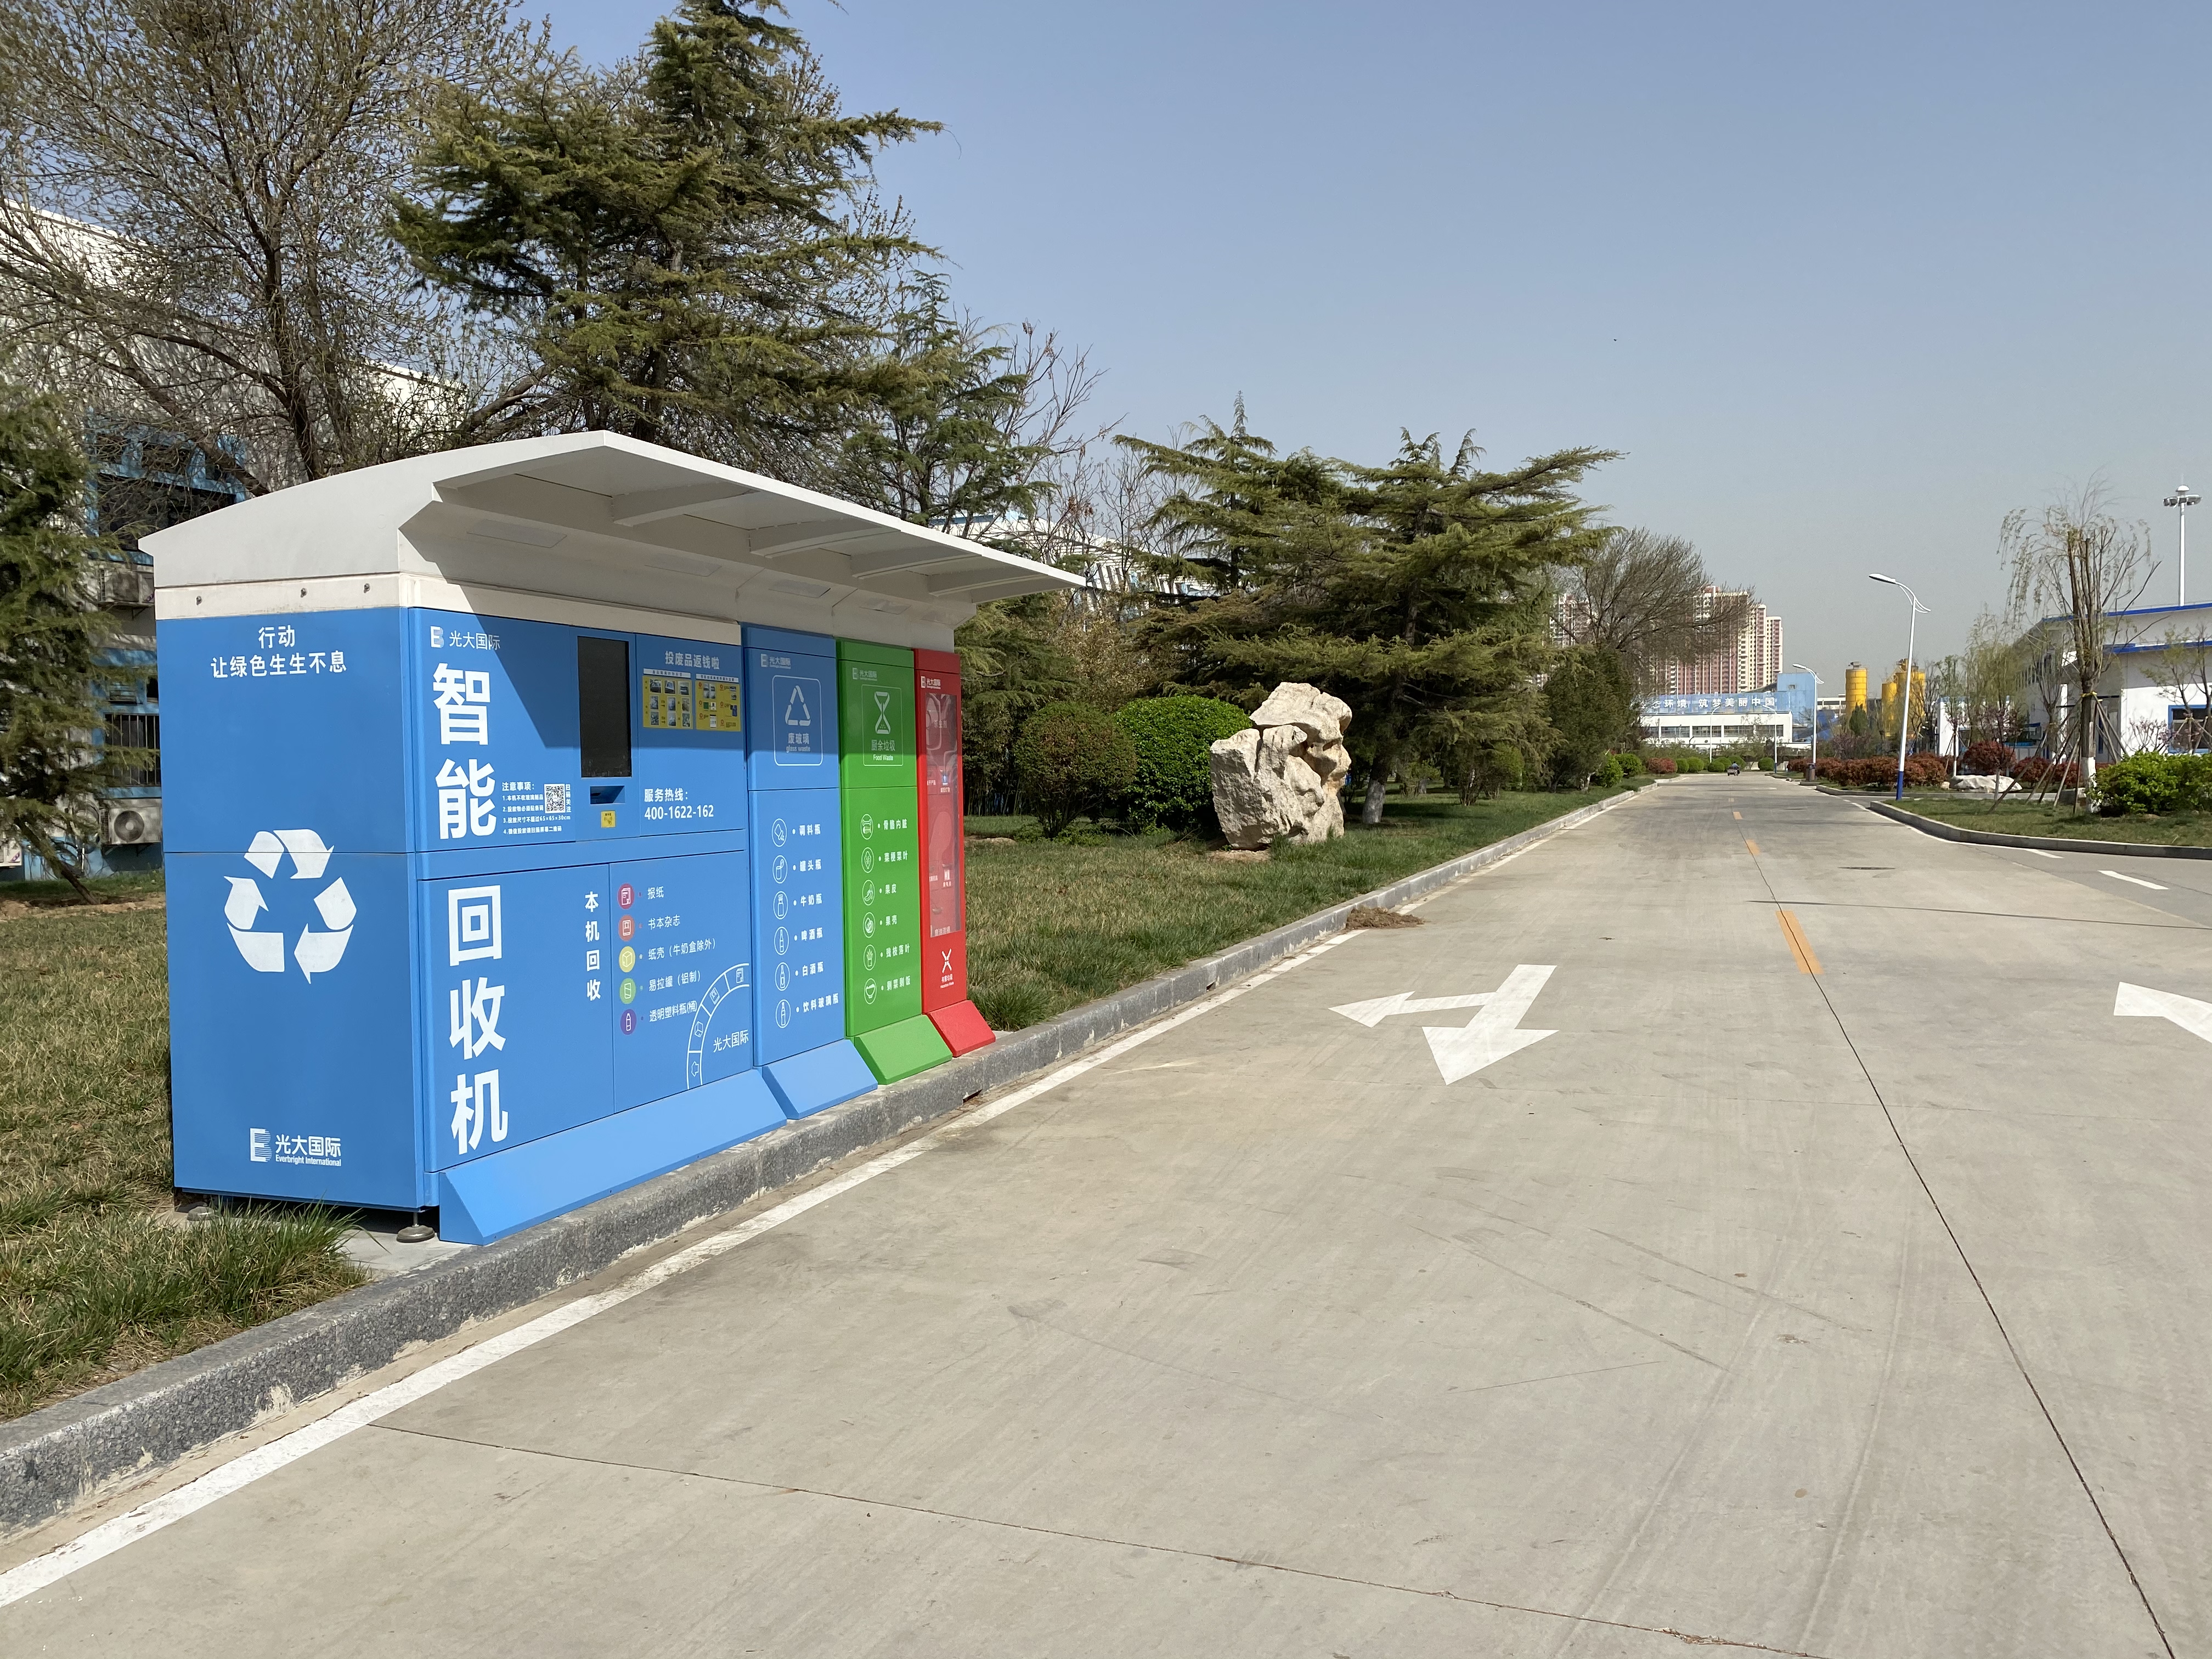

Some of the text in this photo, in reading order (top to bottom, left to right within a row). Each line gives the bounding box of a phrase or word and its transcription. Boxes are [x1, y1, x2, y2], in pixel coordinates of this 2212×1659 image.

[258, 624, 296, 649] 行动
[449, 630, 501, 651] 光大国际
[210, 650, 347, 678] 让绿色生生不息
[665, 651, 720, 670] 投废品返钱啦
[1699, 696, 1775, 708] 筑梦美丽中国
[788, 732, 809, 744] 废玻璃
[871, 739, 895, 752] 厨余垃圾
[644, 788, 688, 803] 服务热线：
[644, 804, 714, 820] 400-1622-162
[799, 823, 821, 836] 调料瓶
[799, 859, 821, 872] 罐头瓶
[647, 885, 664, 900] 报纸
[885, 883, 896, 895] 果皮
[800, 893, 822, 907] 牛奶瓶
[433, 662, 509, 1155] 智能回收机
[647, 914, 681, 930] 书本杂志
[885, 915, 897, 926] 果壳
[801, 927, 823, 941] 啤酒瓶
[584, 890, 601, 1001] 本机回收
[802, 961, 823, 977] 白酒瓶
[887, 975, 911, 991] 剩菜剩饭
[803, 992, 839, 1013] 饮料玻璃瓶
[713, 1029, 749, 1053] 光大国际
[275, 1133, 341, 1158] 光大国际
[275, 1154, 342, 1167] Everbright International
